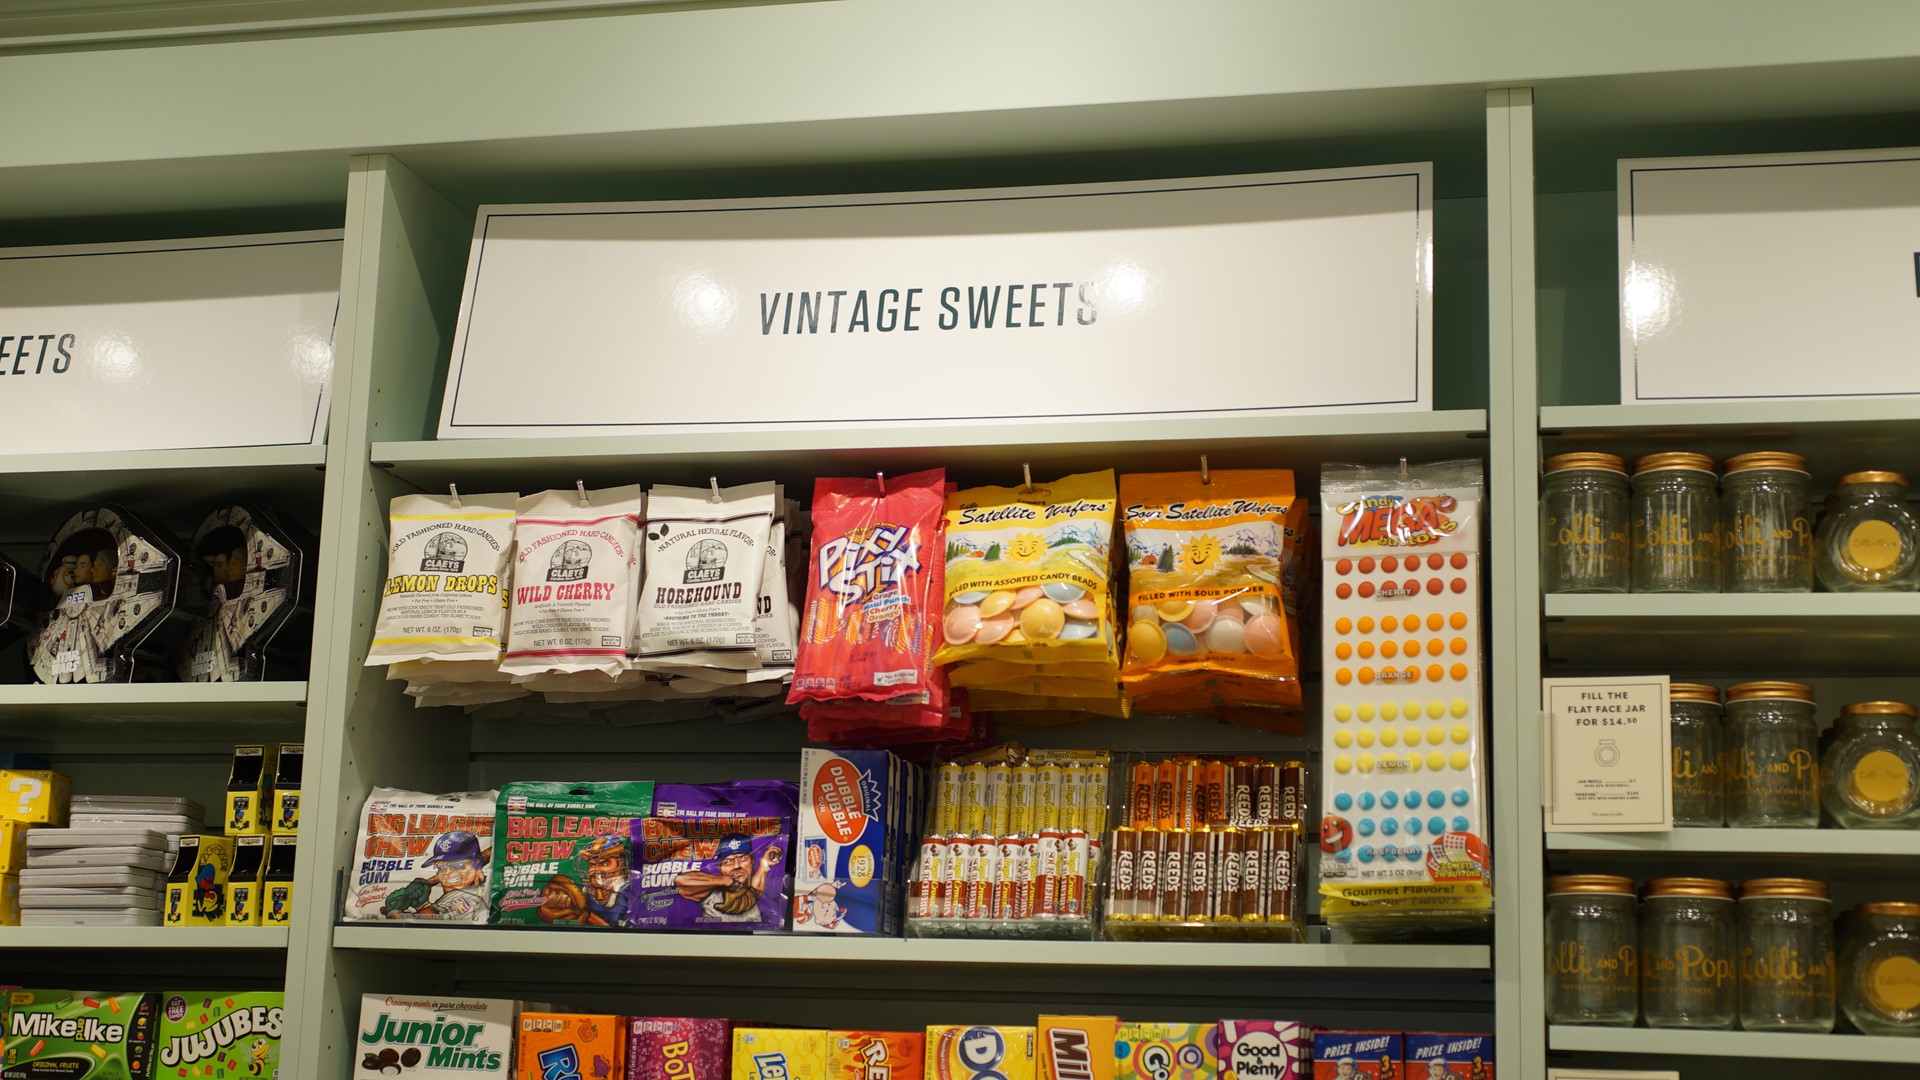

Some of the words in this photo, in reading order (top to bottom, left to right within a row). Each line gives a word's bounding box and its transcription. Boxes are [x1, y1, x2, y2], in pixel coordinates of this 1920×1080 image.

[760, 288, 923, 335] VINTAGE
[938, 280, 1098, 330] SWEETS
[959, 506, 1037, 525] Satellite
[1044, 499, 1108, 519] Wafers
[1165, 502, 1233, 521] Satellite
[1232, 500, 1288, 516] Wafers
[406, 522, 453, 541] FASHIONED
[454, 523, 477, 534] HARD
[698, 528, 729, 536] HERBAL
[1338, 502, 1440, 546] MEGA
[531, 529, 578, 549] FASHIONED
[1610, 531, 1626, 542] AND
[1698, 532, 1715, 543] AND
[1772, 529, 1793, 540] AND
[425, 560, 460, 569] CLAEYS
[551, 568, 584, 578] CLAEYS
[688, 569, 720, 579] CLAEYS
[970, 580, 993, 588] WITH
[994, 575, 1038, 586] ASSORTED
[1040, 572, 1071, 581] CANDY
[1071, 574, 1098, 590] BEADS
[385, 575, 440, 597] LEMON
[444, 575, 497, 595] DROPS
[517, 585, 552, 605] WILD
[556, 582, 615, 601] CHERRY
[656, 582, 742, 604] HOREHOUND
[1375, 588, 1412, 597] CHERRY
[873, 590, 898, 601] Grape
[1138, 592, 1165, 602] FILLED
[1168, 590, 1191, 598] WITH
[1194, 589, 1221, 597] SOUR
[863, 601, 882, 611] Maui
[868, 611, 900, 623] Orange
[667, 639, 679, 647] NET
[52, 660, 79, 676] WARS
[1374, 671, 1414, 679] ORANGE
[1581, 692, 1604, 700] FILL
[1608, 691, 1629, 699] THE
[1596, 705, 1622, 713] FACE
[1625, 704, 1646, 712] JAR
[1576, 718, 1598, 726] FOR
[1602, 717, 1638, 726] $14.50
[1376, 760, 1412, 768] LEMON
[1701, 763, 1718, 775] AND
[1767, 762, 1789, 773] AND
[830, 766, 862, 819] DUBBLE
[861, 780, 871, 812] ORIGINAL
[1159, 782, 1173, 819] REED'S
[818, 796, 826, 813] GUM
[821, 782, 853, 836] BUBBLE
[1135, 783, 1151, 821] REED'S
[367, 813, 406, 835] BIG
[406, 814, 495, 836] LEAGUE
[507, 816, 548, 839] BIG
[641, 817, 684, 840] BIG
[687, 816, 782, 838] LEAGUE
[364, 836, 434, 859] CHEW
[506, 840, 577, 863] CHEW
[643, 839, 720, 862] CHEW
[1366, 848, 1422, 857] RASPBERRY
[360, 860, 414, 873] BUBBLE
[503, 862, 559, 877] BUBBLE
[642, 861, 702, 875] BUBBLE
[856, 855, 866, 877] 1928
[1117, 850, 1133, 891] REED'S
[1140, 850, 1157, 891] REED'S
[1165, 851, 1181, 892] REED'S
[1191, 851, 1207, 892] REED'S
[1224, 852, 1240, 893] REED'S
[1243, 850, 1259, 891] REED'S
[1274, 850, 1291, 891] REED'S
[358, 872, 390, 886] GUM
[503, 875, 535, 888] GUM
[641, 873, 678, 888] GUM
[1342, 885, 1398, 897] Gourmet
[1403, 885, 1455, 895] Flavors!
[1596, 959, 1619, 970] AND
[1656, 959, 1676, 971] AND
[1809, 964, 1827, 976] AND
[168, 1006, 184, 1014] FREE
[385, 996, 412, 1011] Creamy
[438, 1002, 455, 1011] pure
[456, 1001, 488, 1010] chocolate
[11, 1012, 77, 1037] Mike
[75, 1018, 86, 1041] and
[84, 1018, 124, 1043] Ike
[160, 1006, 284, 1067] JUJUBES
[361, 1014, 484, 1046] Junior
[1237, 1043, 1280, 1058] Good
[1324, 1043, 1352, 1059] PRIZE
[1355, 1036, 1390, 1054] INSIDE!
[1416, 1044, 1444, 1059] PRIZE
[1447, 1037, 1483, 1054] INSIDE!
[426, 1047, 502, 1071] Mints
[1256, 1057, 1263, 1065] &
[1381, 1055, 1390, 1073] 3
[1473, 1056, 1483, 1074] 3
[1236, 1061, 1285, 1080] Plenty
